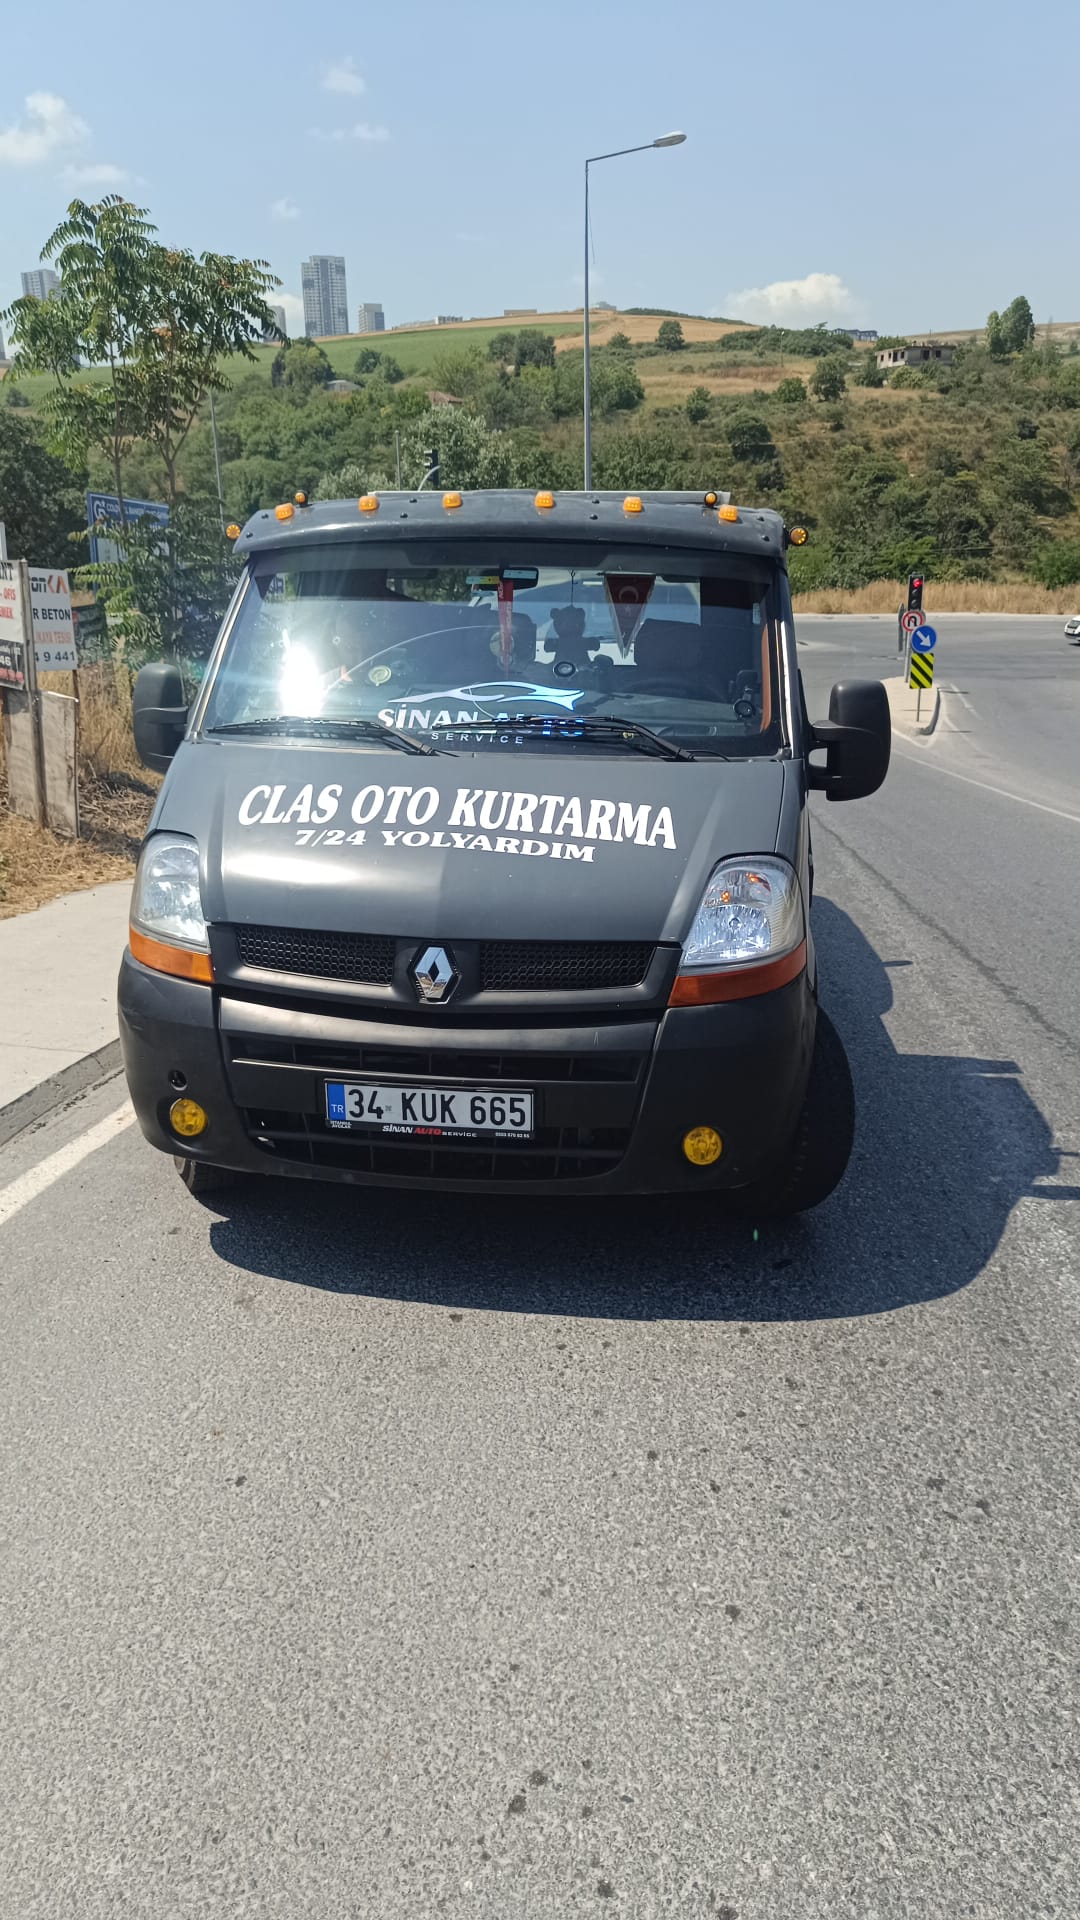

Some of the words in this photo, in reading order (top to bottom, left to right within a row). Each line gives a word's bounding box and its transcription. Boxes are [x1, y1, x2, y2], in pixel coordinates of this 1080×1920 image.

[41, 608, 71, 620] BETON
[55, 650, 75, 661] 441
[238, 784, 343, 826] CLAS
[351, 784, 440, 826] OTO
[447, 788, 677, 850] KURTARMA
[295, 829, 366, 848] 7/24
[381, 830, 596, 862] YOLYARDIM
[331, 1104, 344, 1113] TR
[348, 1088, 384, 1119] 34
[401, 1092, 456, 1123] KUK
[469, 1096, 526, 1127] 665
[415, 1127, 442, 1136] AUTO
